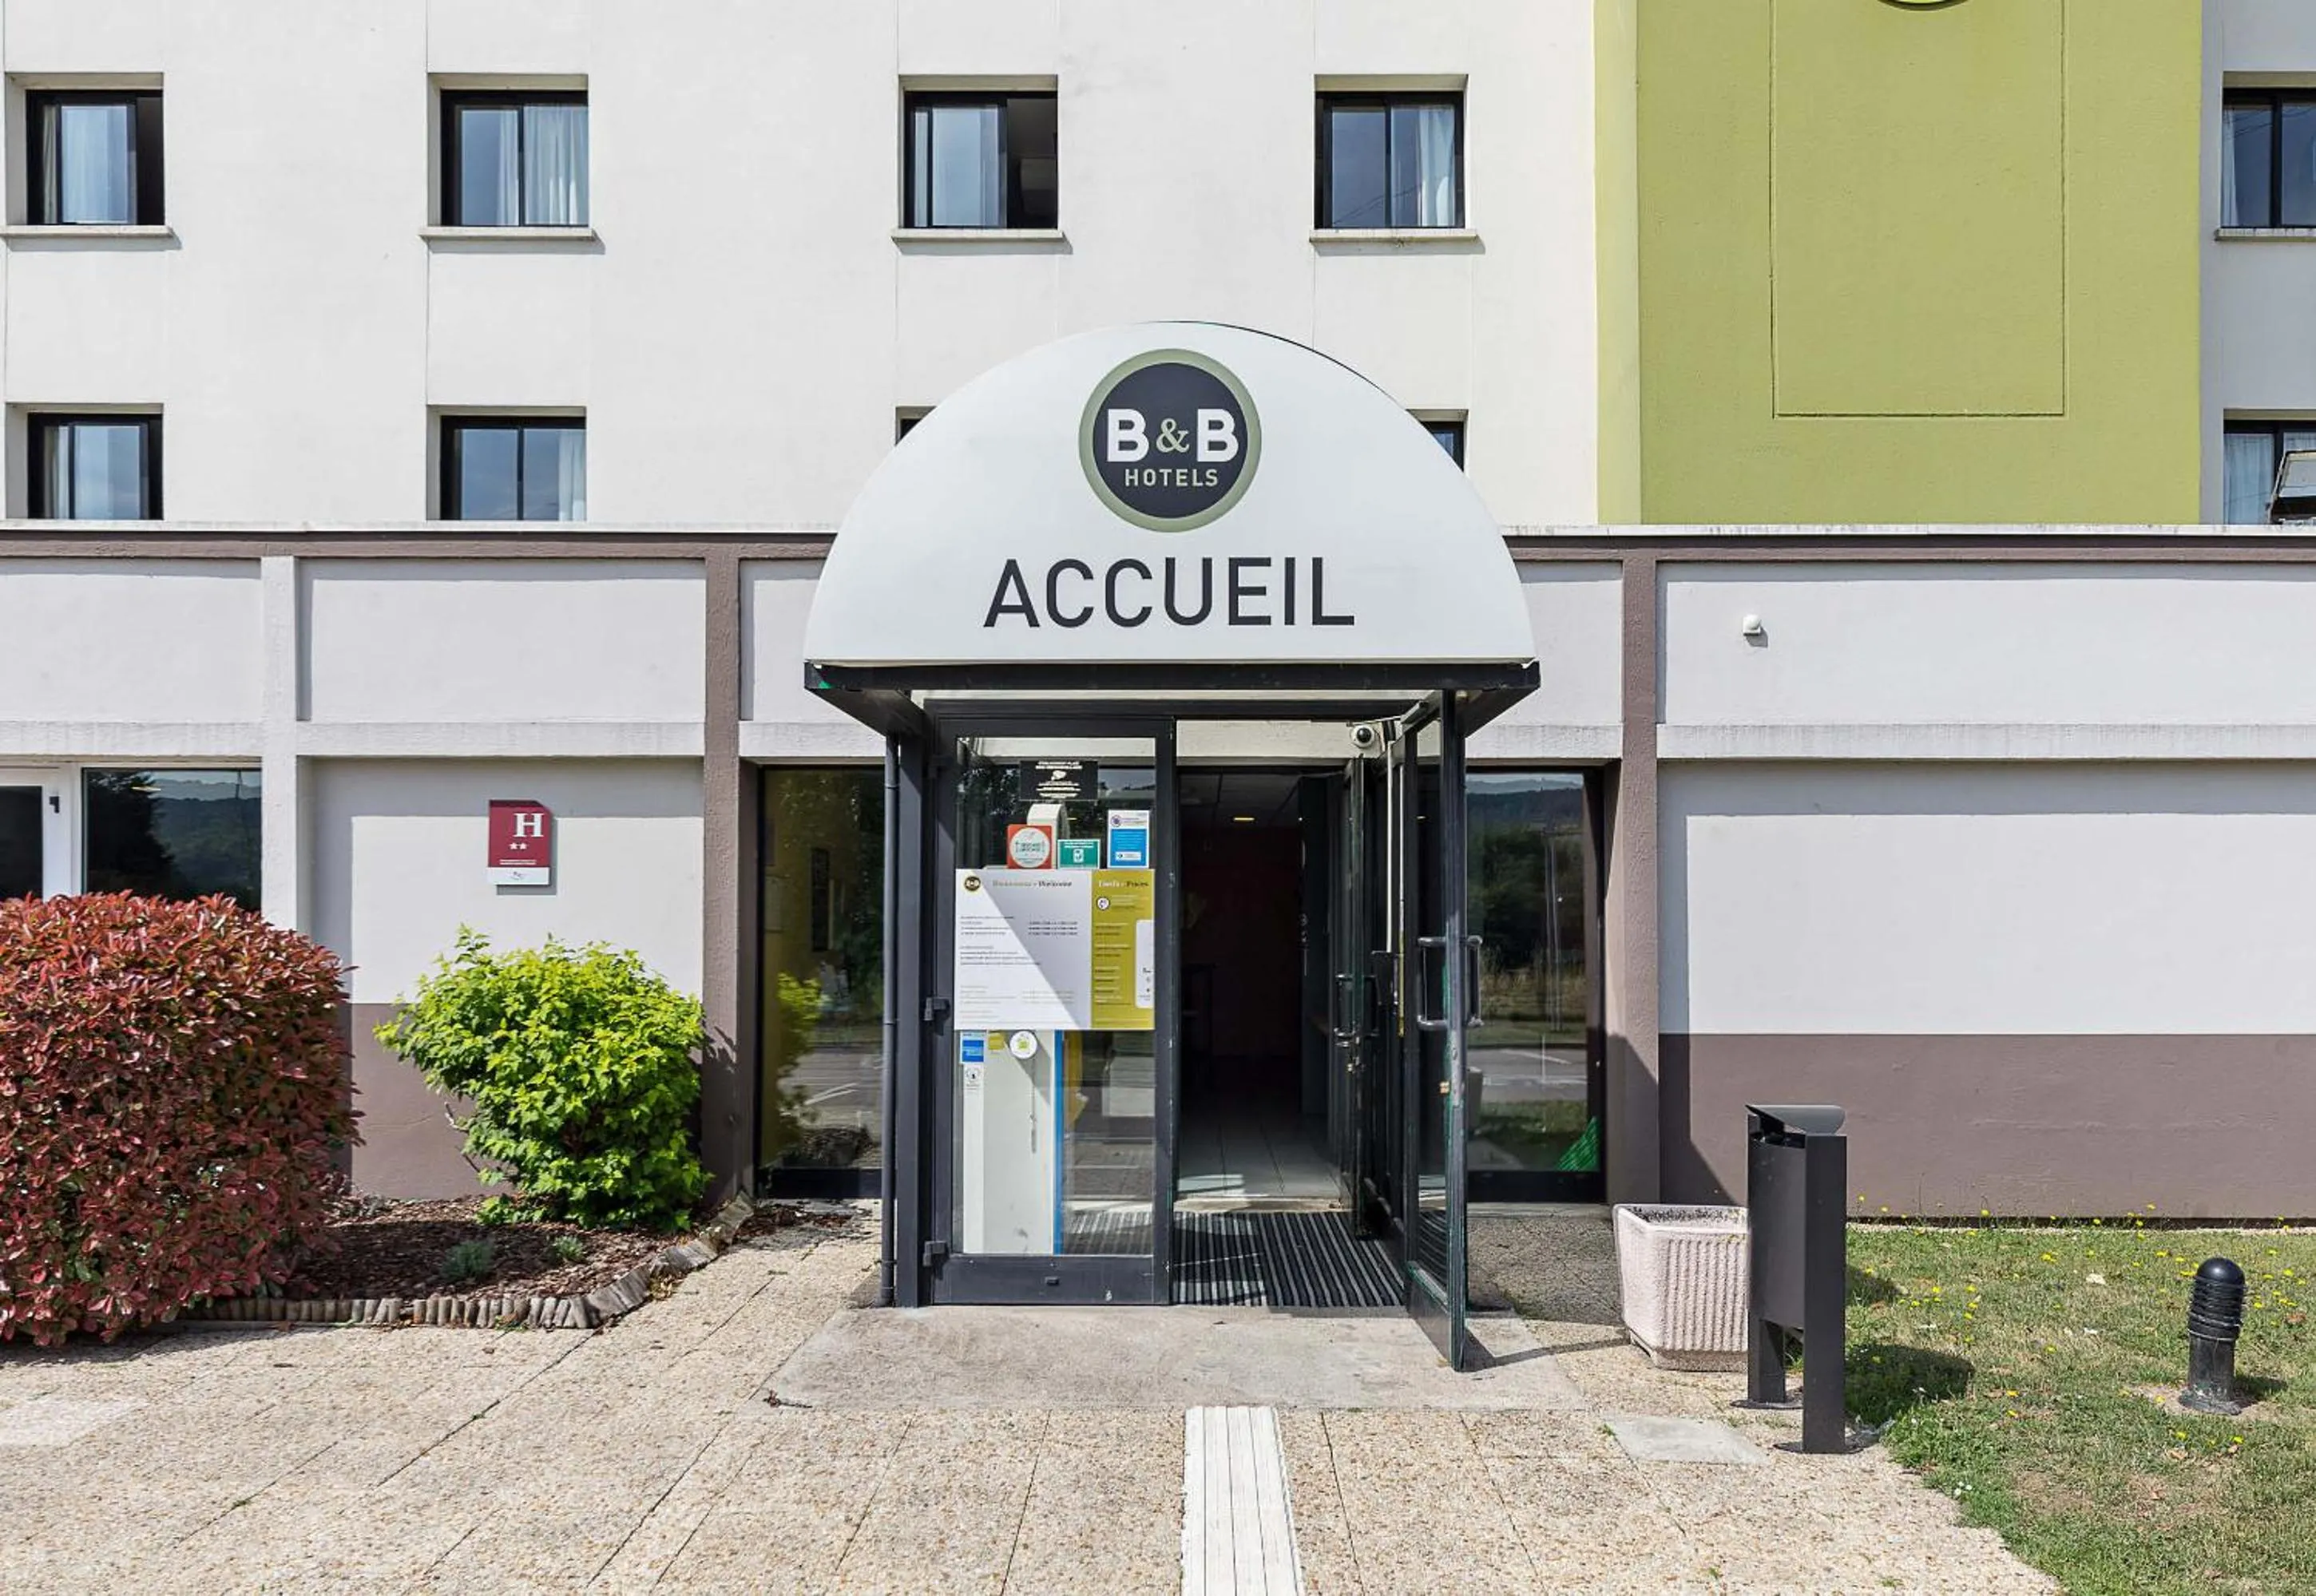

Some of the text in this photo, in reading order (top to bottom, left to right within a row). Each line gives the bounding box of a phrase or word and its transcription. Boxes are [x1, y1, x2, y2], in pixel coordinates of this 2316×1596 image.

[1107, 408, 1239, 462] B&B
[1124, 468, 1219, 487] HOTELS
[983, 556, 1355, 628] ACCUEIL
[512, 812, 545, 838] H
